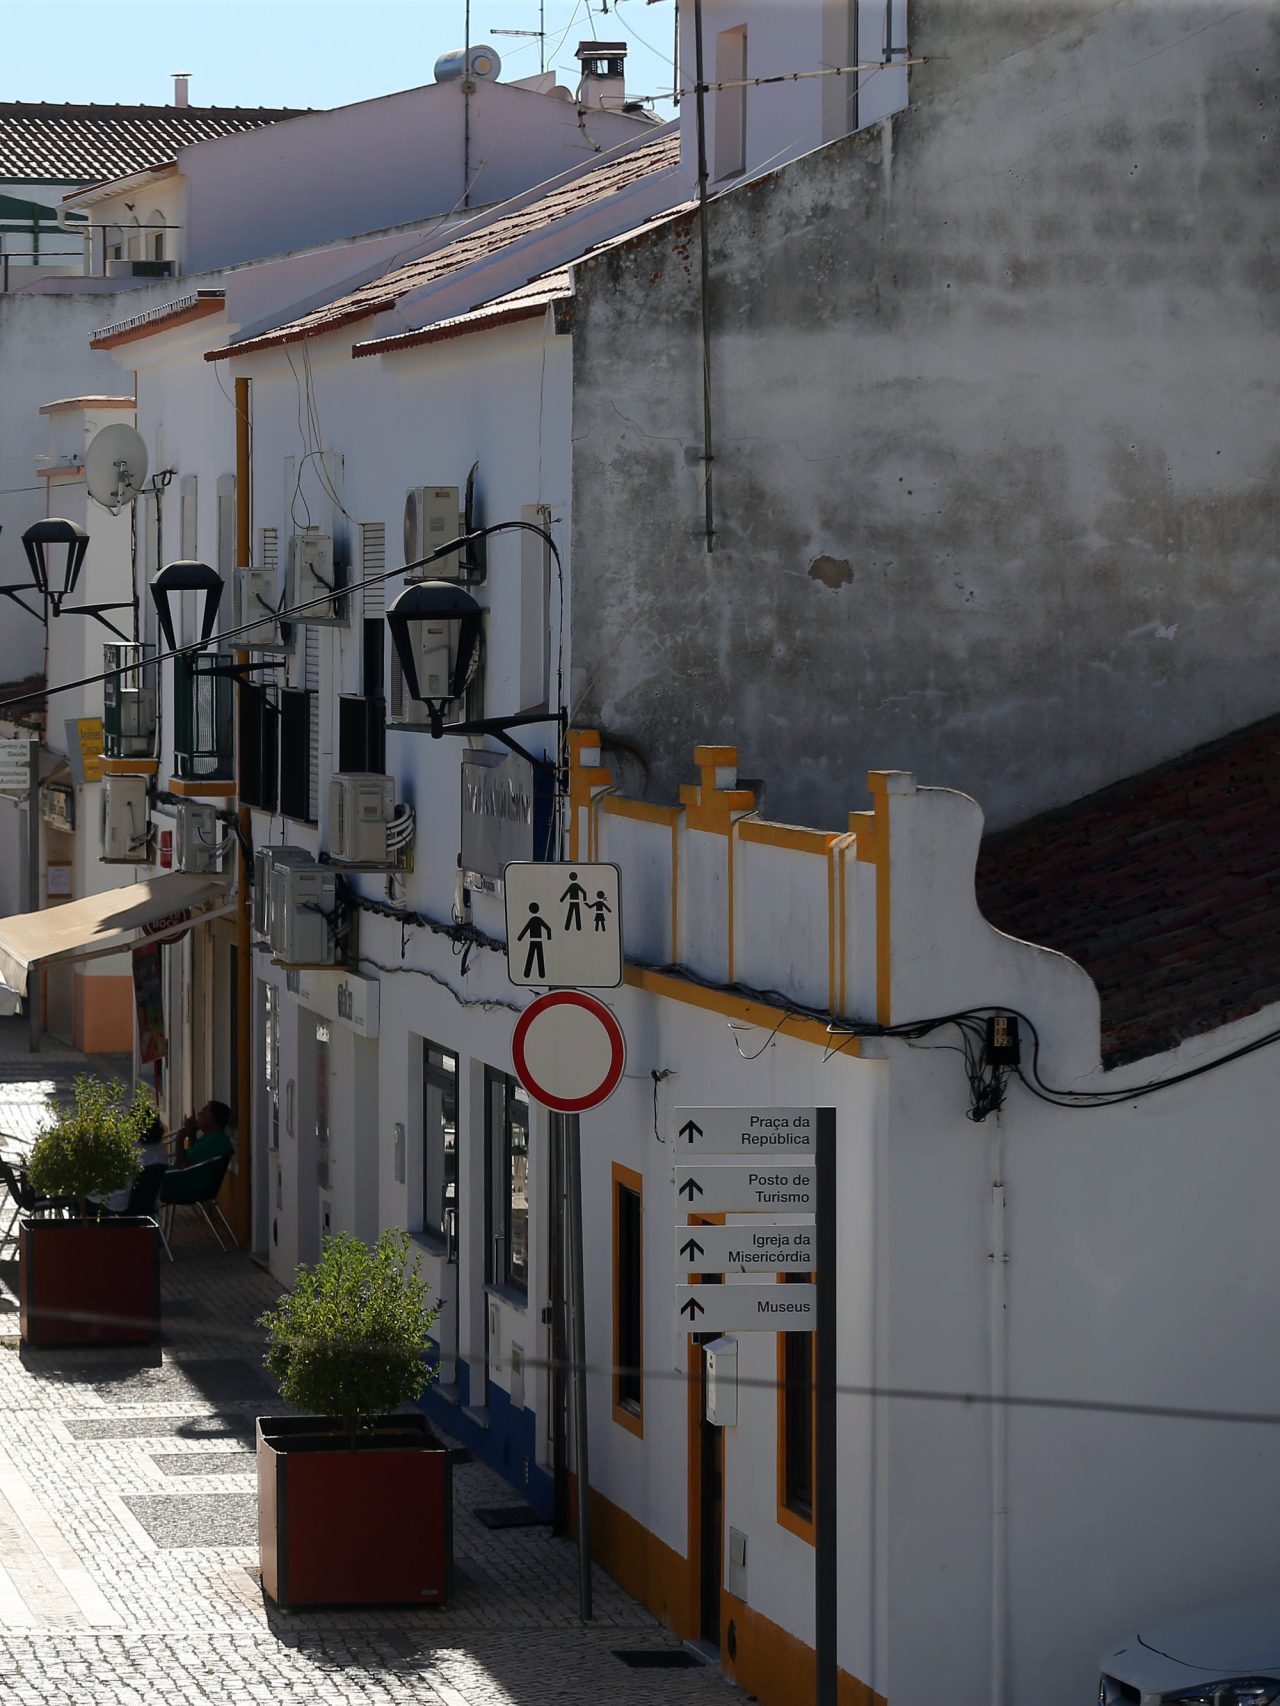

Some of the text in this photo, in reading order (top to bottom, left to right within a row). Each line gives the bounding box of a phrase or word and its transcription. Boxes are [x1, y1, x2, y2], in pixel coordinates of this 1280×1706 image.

[750, 1115, 810, 1131] Praça da
[741, 1132, 810, 1148] República
[748, 1174, 810, 1186] Posto de
[755, 1190, 810, 1203] Turismo
[752, 1233, 811, 1248] Igreja da
[728, 1250, 811, 1263] Misericórdia
[757, 1301, 811, 1313] Museus
